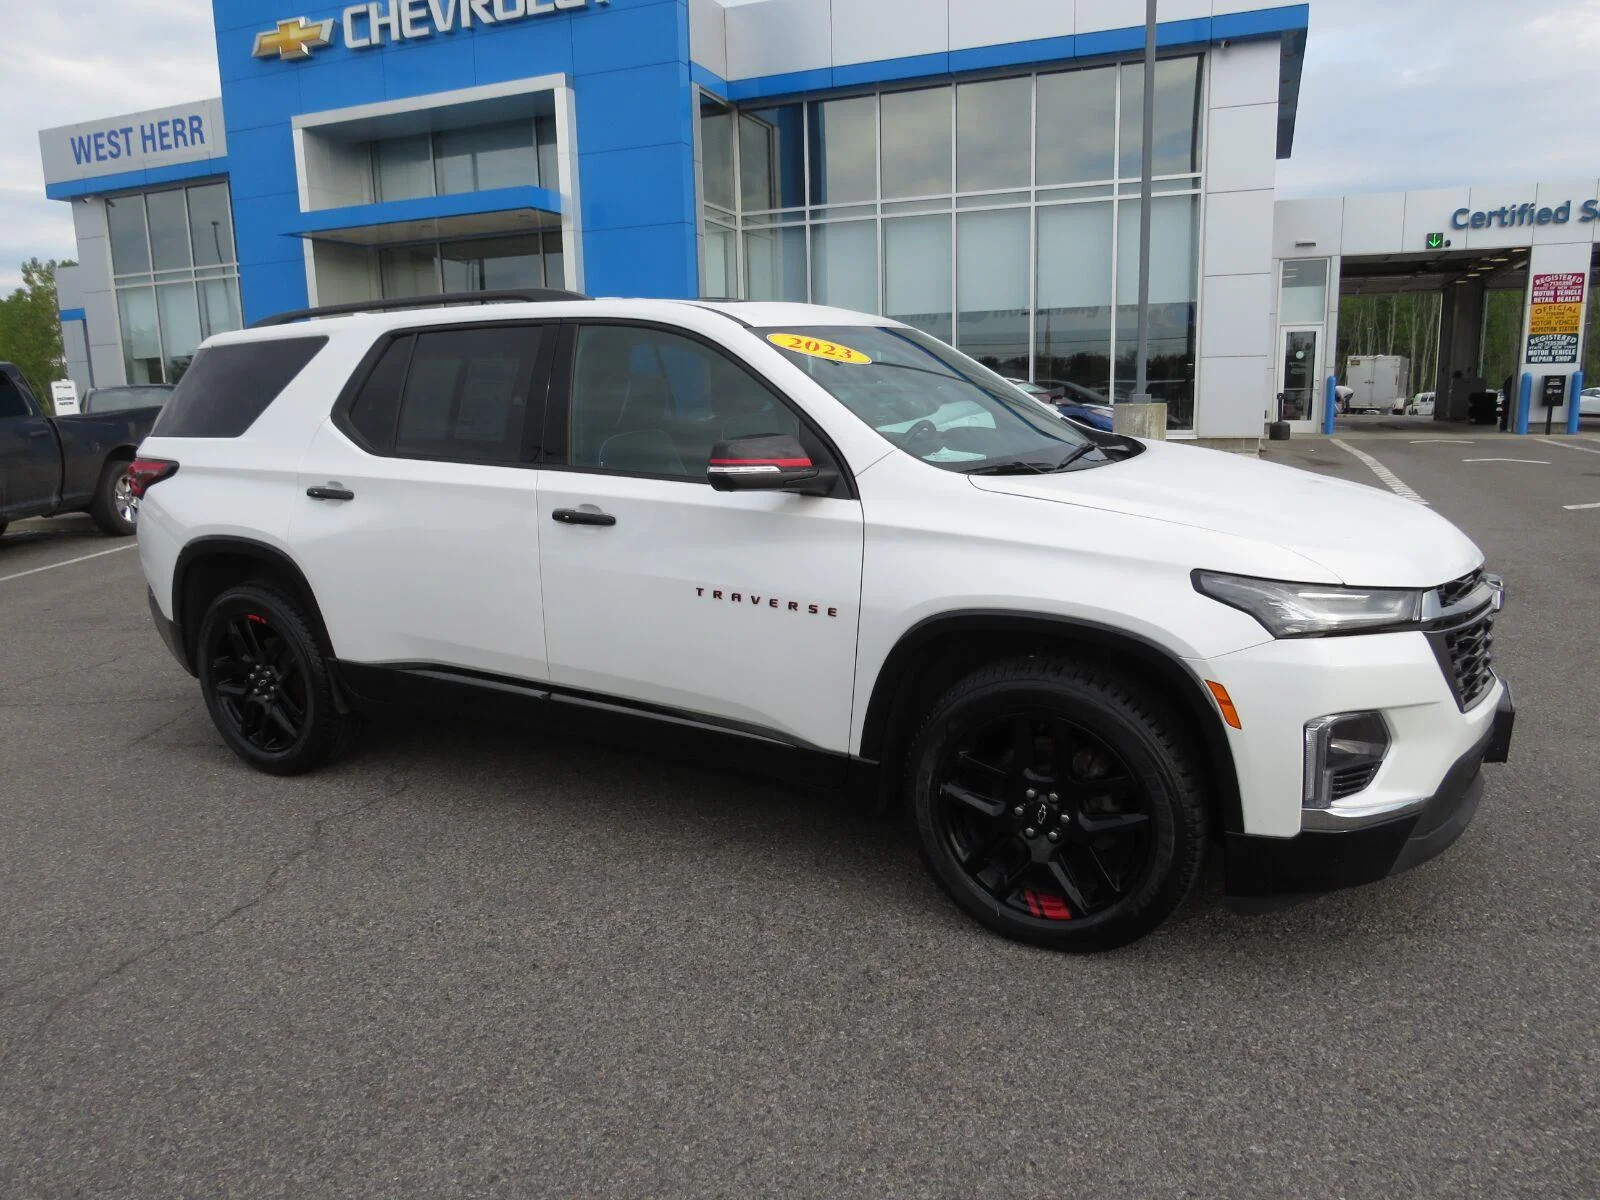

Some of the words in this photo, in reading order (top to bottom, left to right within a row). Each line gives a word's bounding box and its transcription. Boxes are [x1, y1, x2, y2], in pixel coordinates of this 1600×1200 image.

[342, 0, 610, 49] CHEVRO
[70, 126, 133, 165] WEST
[140, 115, 206, 153] HERR
[1452, 200, 1572, 230] Certified
[1578, 199, 1600, 223] S
[1535, 274, 1583, 285] REGISTERED
[1535, 305, 1577, 314] OFFICIAL
[788, 337, 852, 359] 2023
[1530, 334, 1577, 344] REGISTERED
[695, 587, 838, 618] TRAVERSE
